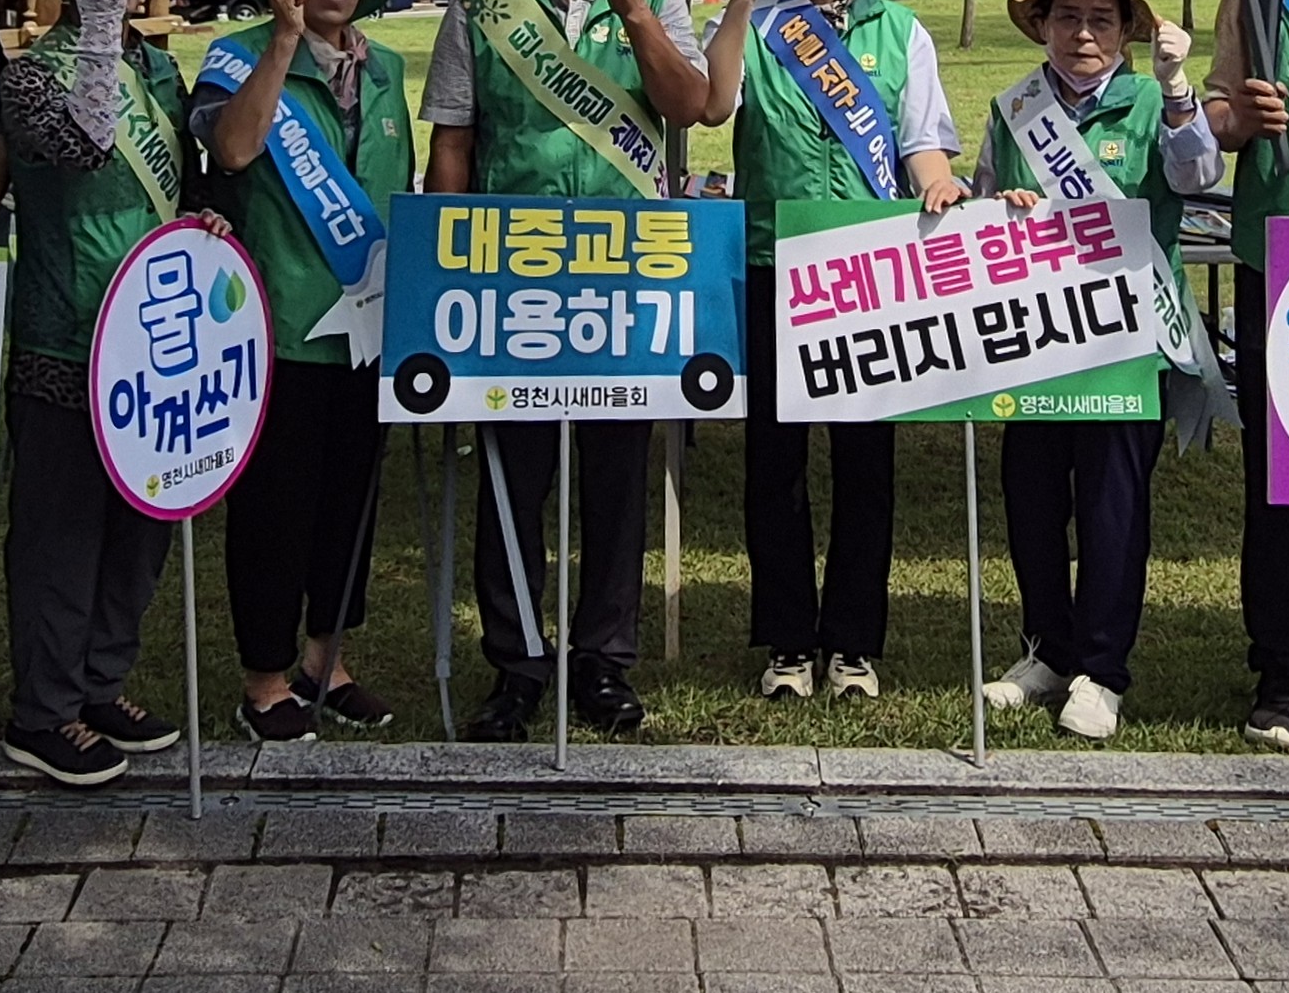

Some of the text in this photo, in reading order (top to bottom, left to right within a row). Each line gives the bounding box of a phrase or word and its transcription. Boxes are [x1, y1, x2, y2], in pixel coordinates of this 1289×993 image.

[508, 20, 658, 173] 탄소중립 실천
[812, 58, 877, 136] 지구는
[869, 135, 899, 200] 우리
[1028, 116, 1096, 199] 나는야
[438, 207, 691, 278] 대중교통
[789, 201, 1123, 326] 쓰레기를 함부로
[139, 249, 203, 377] 물
[434, 288, 694, 359] 이용하기
[798, 275, 1139, 398] 버리지 맙시다
[109, 338, 257, 453] 아껴쓰기
[511, 386, 648, 409] 영천시새마을회
[1020, 394, 1142, 414] 영천시새마을회
[161, 446, 234, 491] 영천시새마을회
